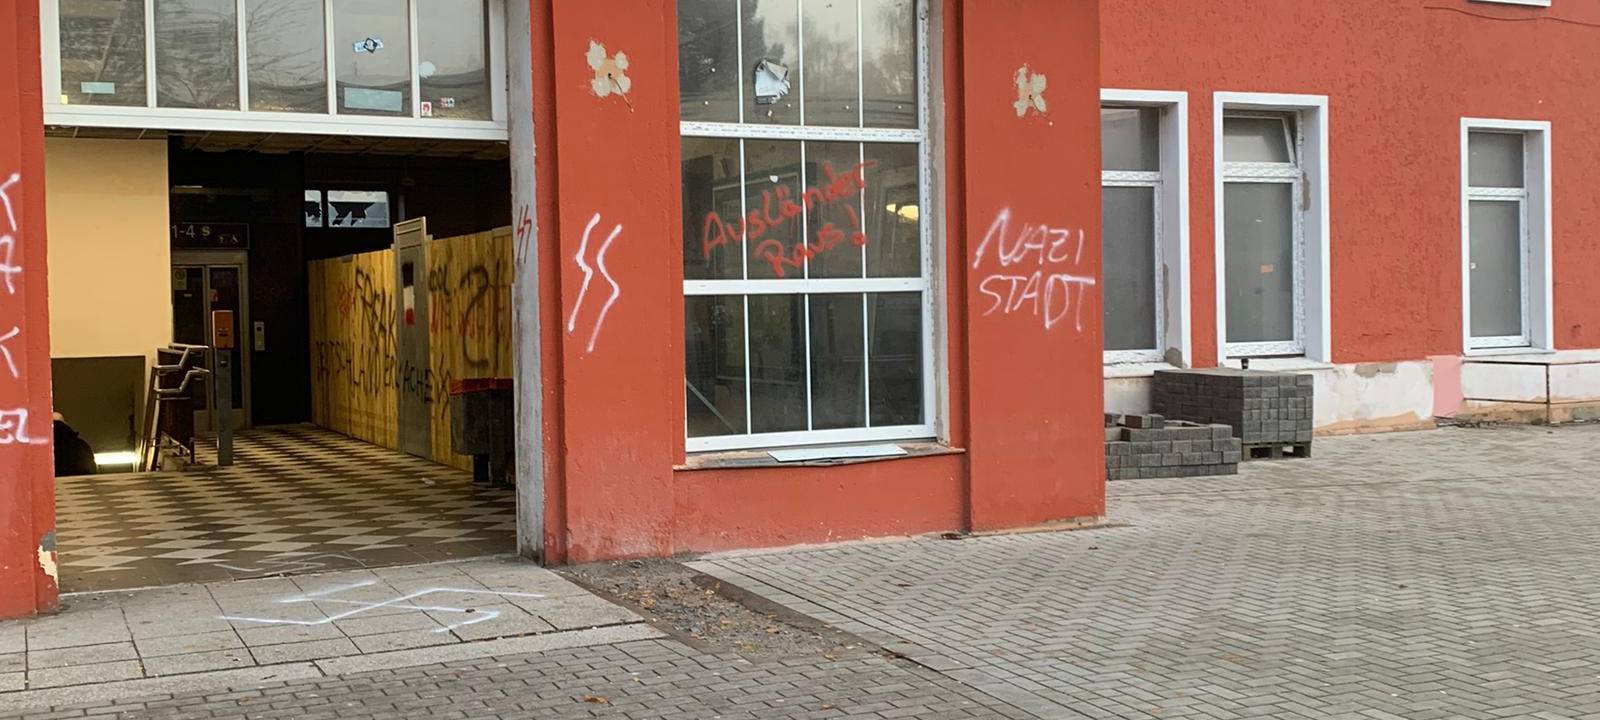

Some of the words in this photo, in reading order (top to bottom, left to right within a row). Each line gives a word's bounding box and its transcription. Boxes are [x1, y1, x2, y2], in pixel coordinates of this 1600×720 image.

[753, 204, 869, 278] Raus!
[973, 207, 1085, 269] NAZI
[979, 270, 1096, 333] STADT
